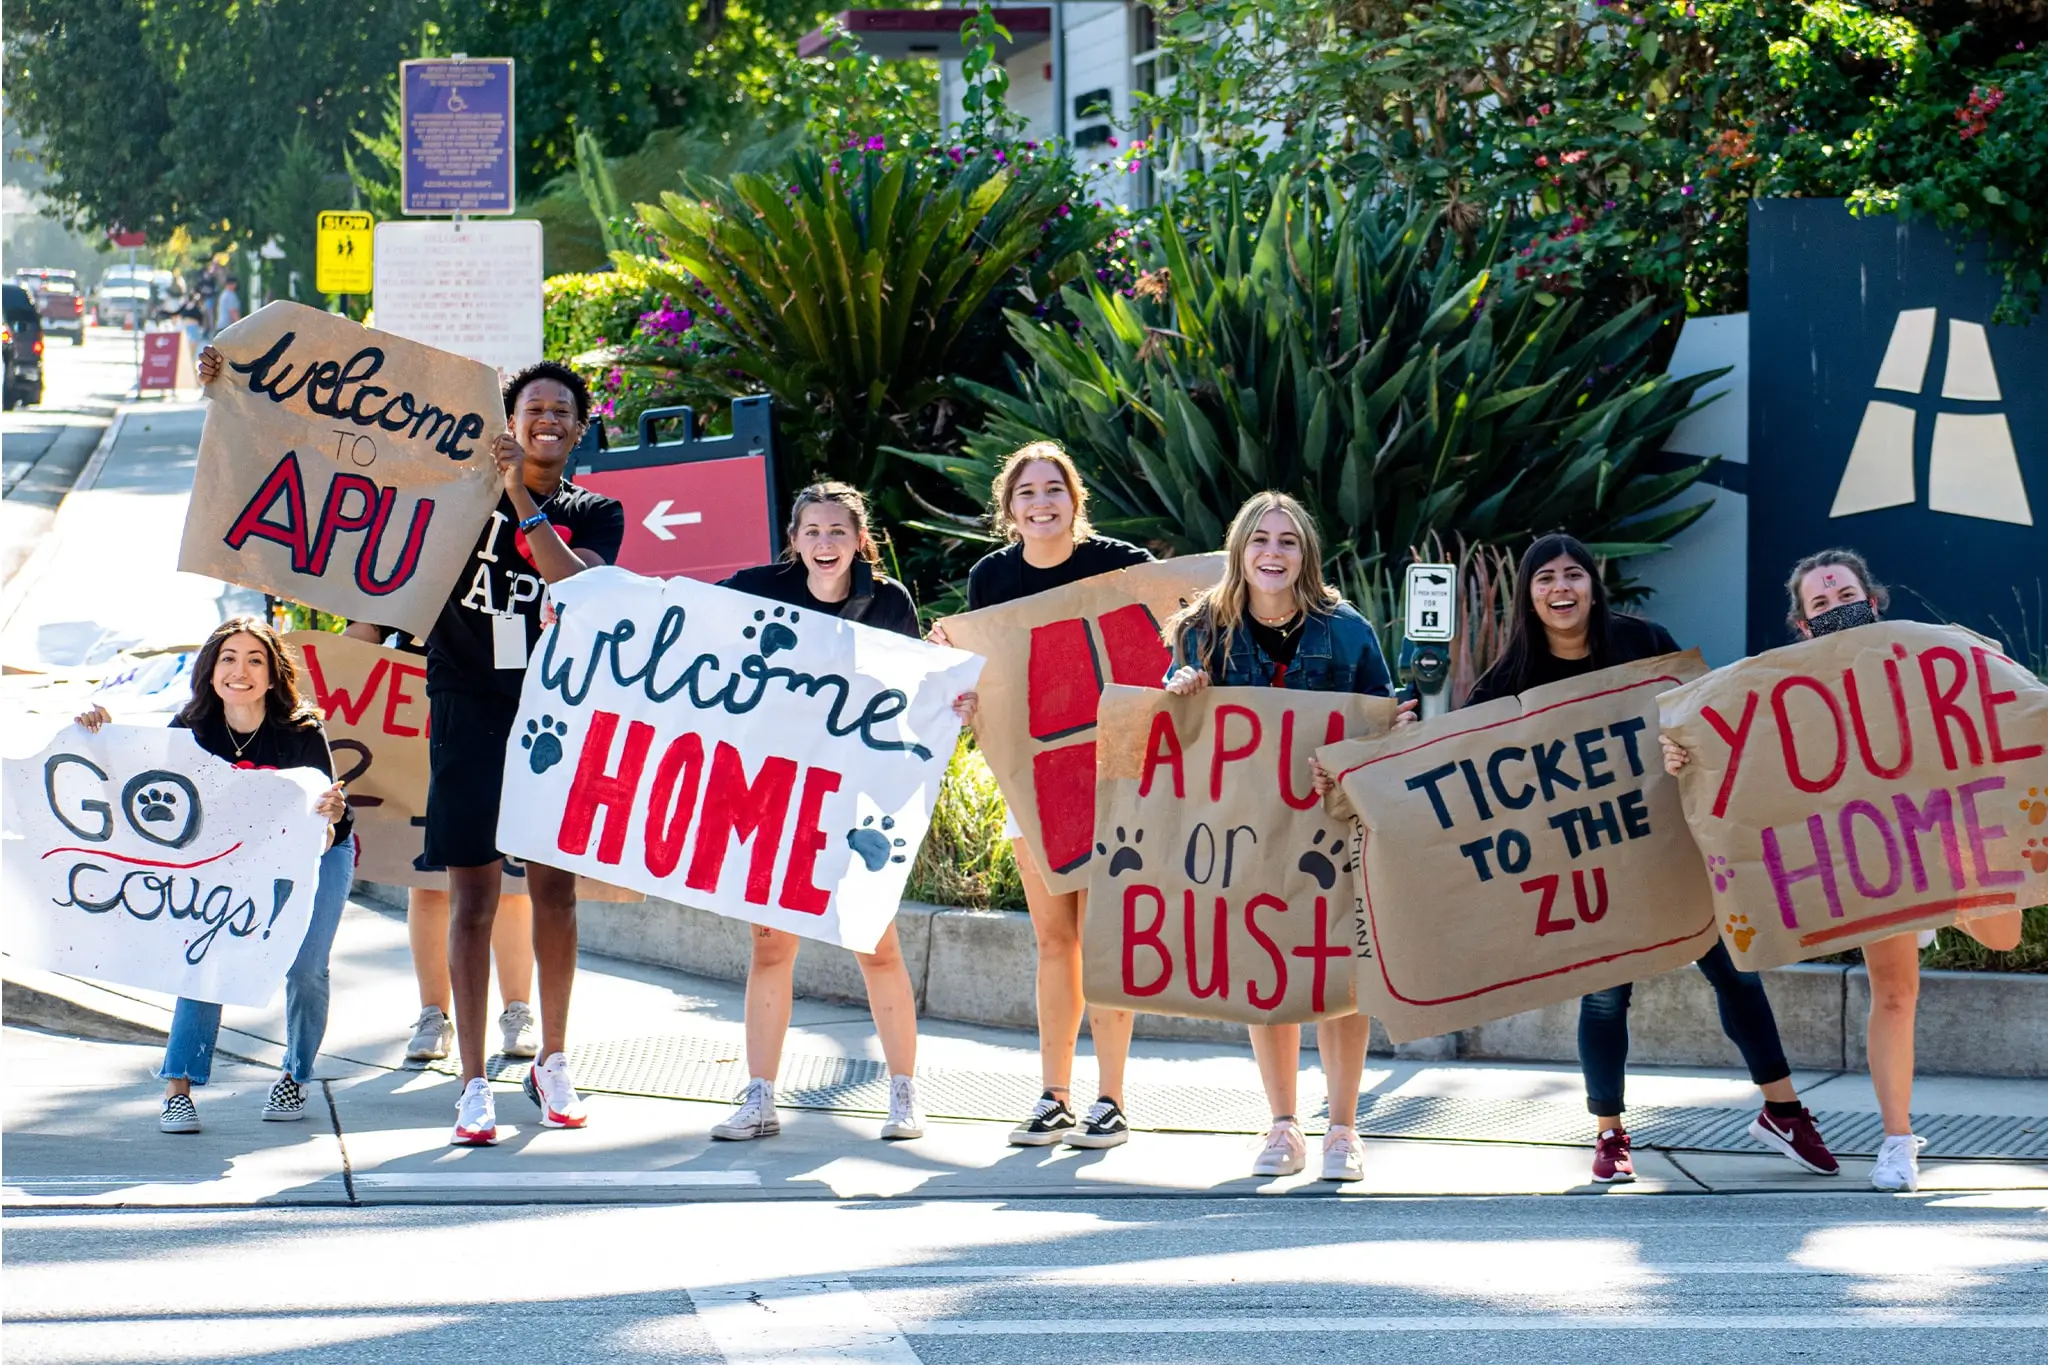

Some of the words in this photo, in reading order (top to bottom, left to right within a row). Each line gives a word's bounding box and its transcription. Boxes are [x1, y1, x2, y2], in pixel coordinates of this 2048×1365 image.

[323, 216, 368, 230] SLOW
[332, 430, 377, 467] TO
[223, 451, 435, 596] APU
[477, 510, 509, 563] I
[1138, 704, 1345, 811] APU
[1405, 716, 1645, 829] TICKET
[1700, 642, 2046, 819] YOU'RE
[44, 753, 204, 849] GO
[557, 709, 842, 916] HOME
[1460, 828, 1532, 882] TO
[1547, 789, 1651, 859] THE
[1761, 776, 2025, 929] HOME
[1355, 897, 1373, 959] MANY
[1520, 867, 1609, 936] ZU
